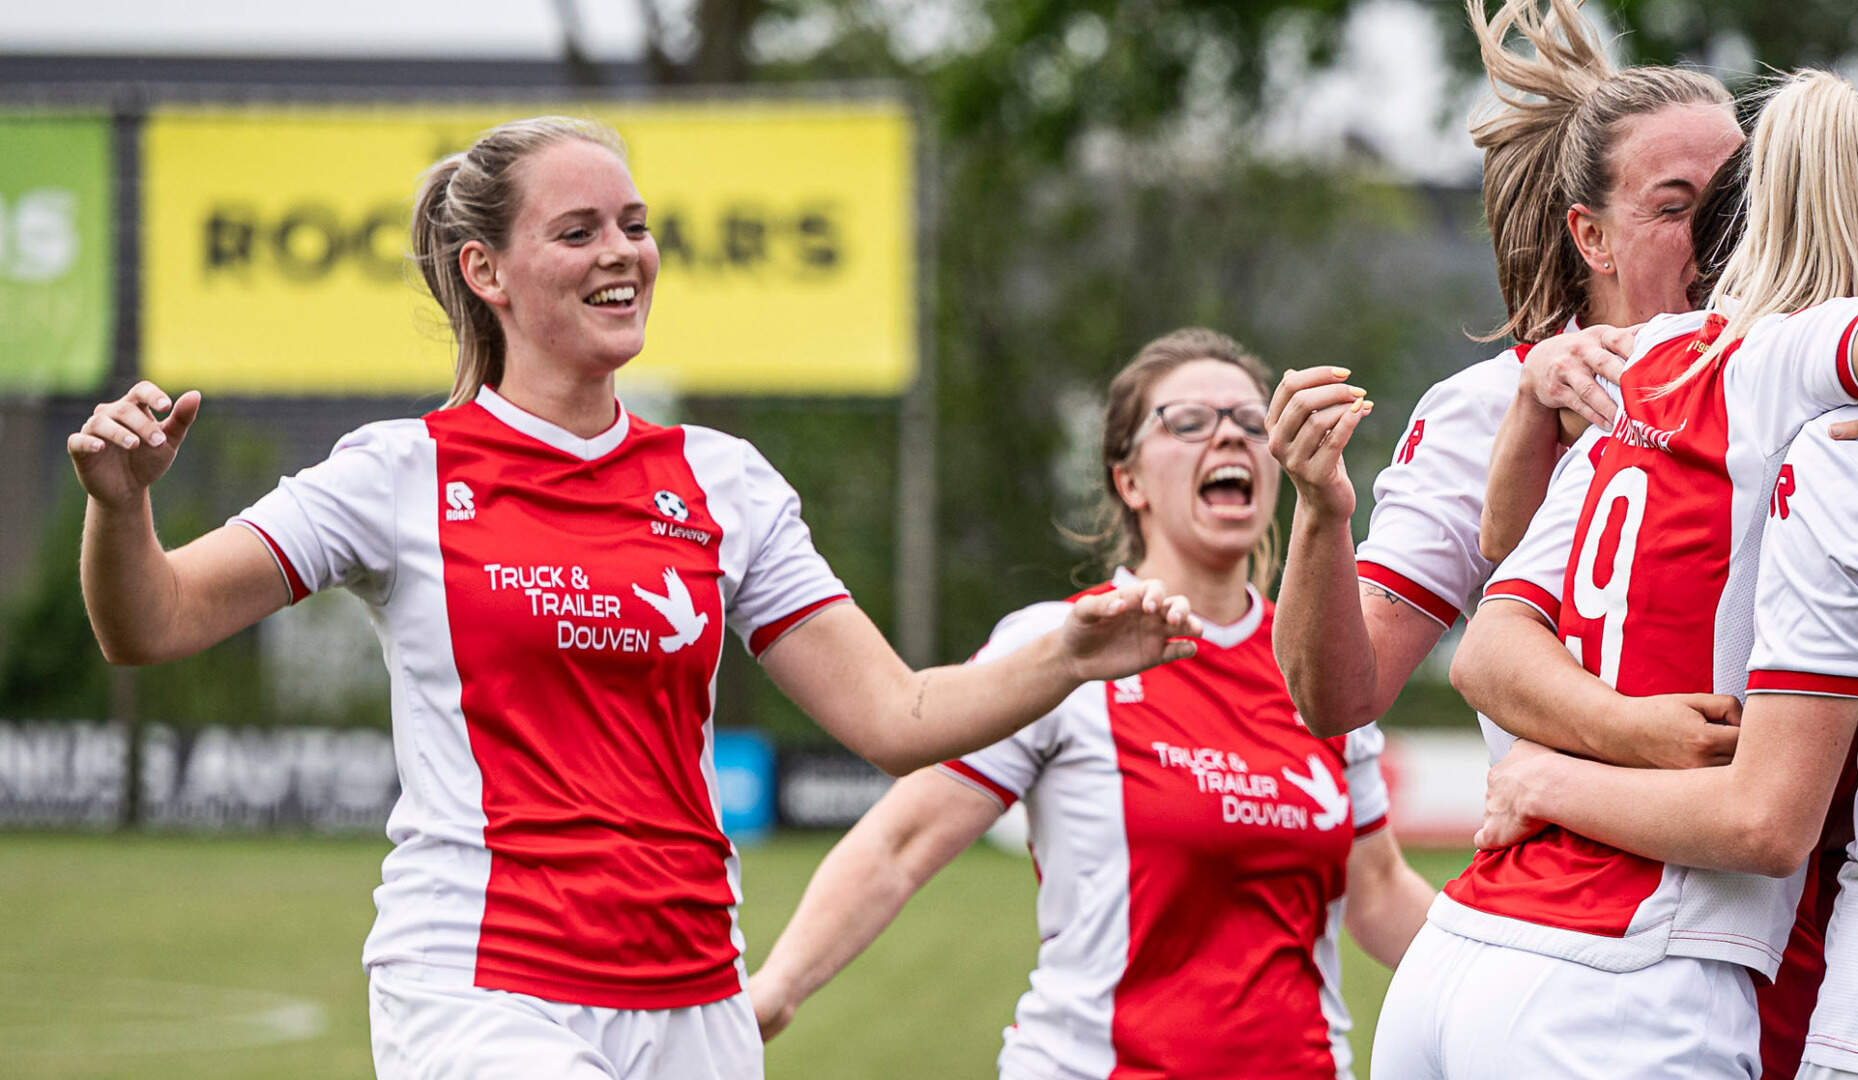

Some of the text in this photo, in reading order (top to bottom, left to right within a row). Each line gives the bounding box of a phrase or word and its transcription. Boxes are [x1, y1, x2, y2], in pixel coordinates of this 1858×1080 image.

[203, 200, 844, 279] ROCARS
[650, 521, 712, 546] SV Leveroy
[484, 564, 590, 590] TRUCK &
[1565, 466, 1648, 690] 9
[524, 588, 622, 619] TRAILER
[557, 620, 650, 653] DOUVEN
[1152, 741, 1248, 774] TRUCK &
[1191, 767, 1279, 799] TRAILER
[1221, 795, 1307, 830] DOUVEN
